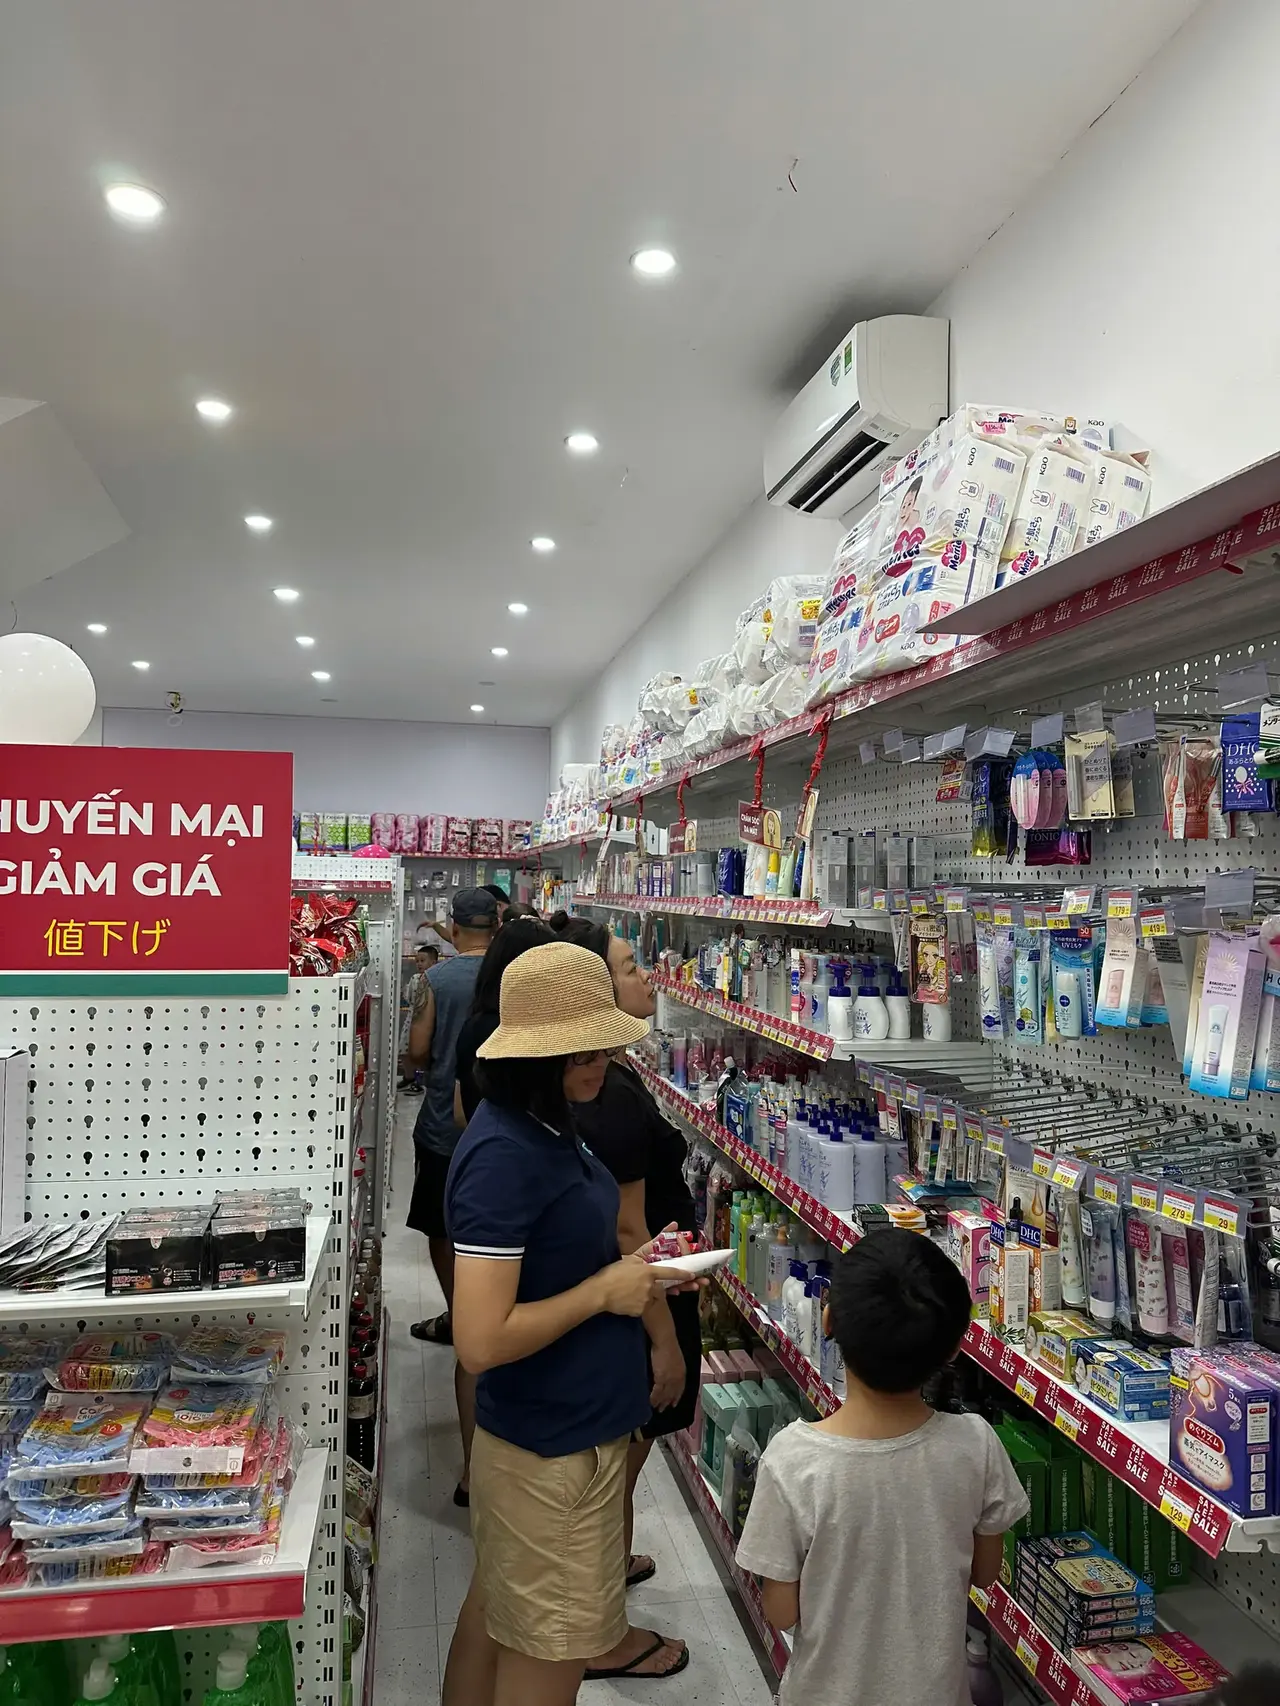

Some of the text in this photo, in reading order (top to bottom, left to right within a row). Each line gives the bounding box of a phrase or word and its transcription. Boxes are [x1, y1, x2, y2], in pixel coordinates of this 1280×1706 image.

[1039, 456, 1049, 475] Kao
[1175, 557, 1200, 574] SALE
[1142, 570, 1165, 587] SALE
[1108, 585, 1128, 600] SALE
[1080, 598, 1098, 612] SALE
[1053, 610, 1072, 623] SALE
[1030, 620, 1047, 633] SALE
[1007, 630, 1023, 643] SALE
[171, 803, 264, 846] MẠI
[132, 854, 222, 896] GIÁ
[1115, 906, 1125, 914] 179
[1053, 919, 1064, 927] 479
[1149, 924, 1160, 933] 419
[44, 919, 171, 957] 値下げ
[1038, 1164, 1048, 1174] 159
[1101, 1189, 1112, 1199] 159
[1171, 1207, 1186, 1219] 279
[991, 1224, 1004, 1237] DHC
[1218, 1218, 1228, 1229] 29
[1020, 1226, 1040, 1241] DHC
[979, 1343, 994, 1359] SALE
[999, 1359, 1015, 1376] SALE
[1044, 1394, 1057, 1411] SAL
[1189, 1423, 1219, 1447] めぐりズム
[1096, 1436, 1117, 1458] SALE
[1126, 1460, 1148, 1483] SALE
[1170, 1506, 1182, 1521] 129
[1192, 1513, 1218, 1539] SALE
[1002, 1612, 1018, 1634] SALE
[1163, 1659, 1199, 1681] 3D
[1048, 1666, 1067, 1691] SALE
